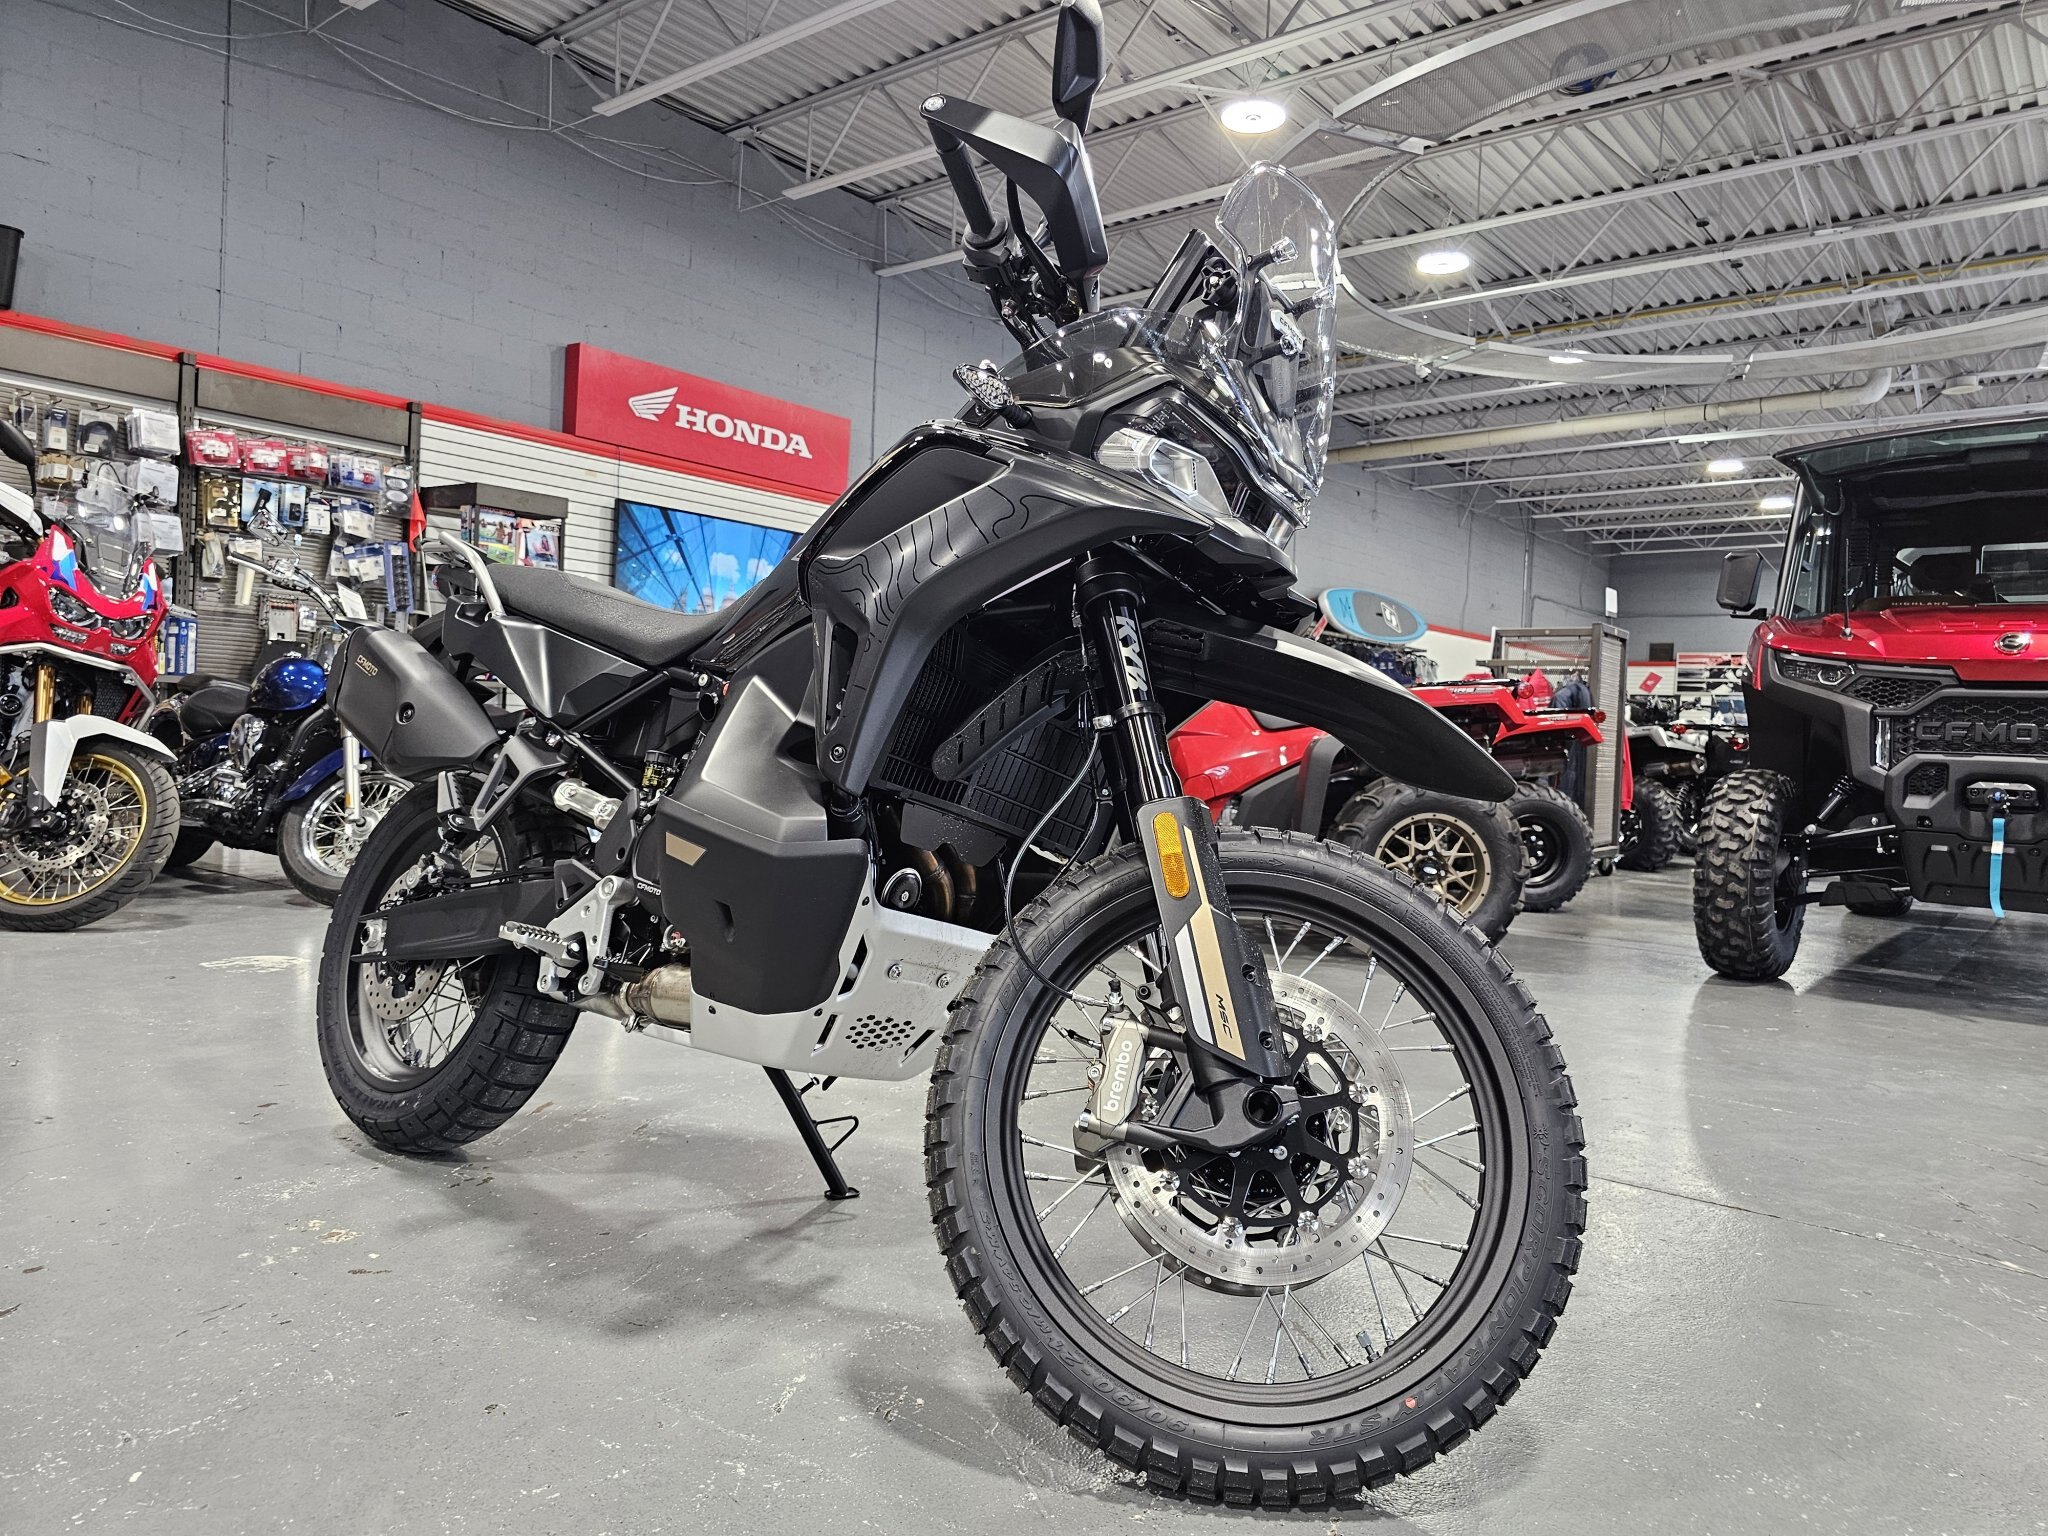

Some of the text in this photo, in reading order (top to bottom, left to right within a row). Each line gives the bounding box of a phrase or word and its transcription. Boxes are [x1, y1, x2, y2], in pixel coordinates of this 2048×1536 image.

[675, 404, 813, 459] HONDA
[356, 654, 379, 676] CFMOTO
[1116, 615, 1148, 692] KYB
[1916, 721, 2048, 744] CFMO
[637, 882, 662, 896] CFMOTO
[1215, 993, 1234, 1039] MSC
[1103, 1040, 1133, 1112] brembo
[1309, 1412, 1382, 1446] STR
